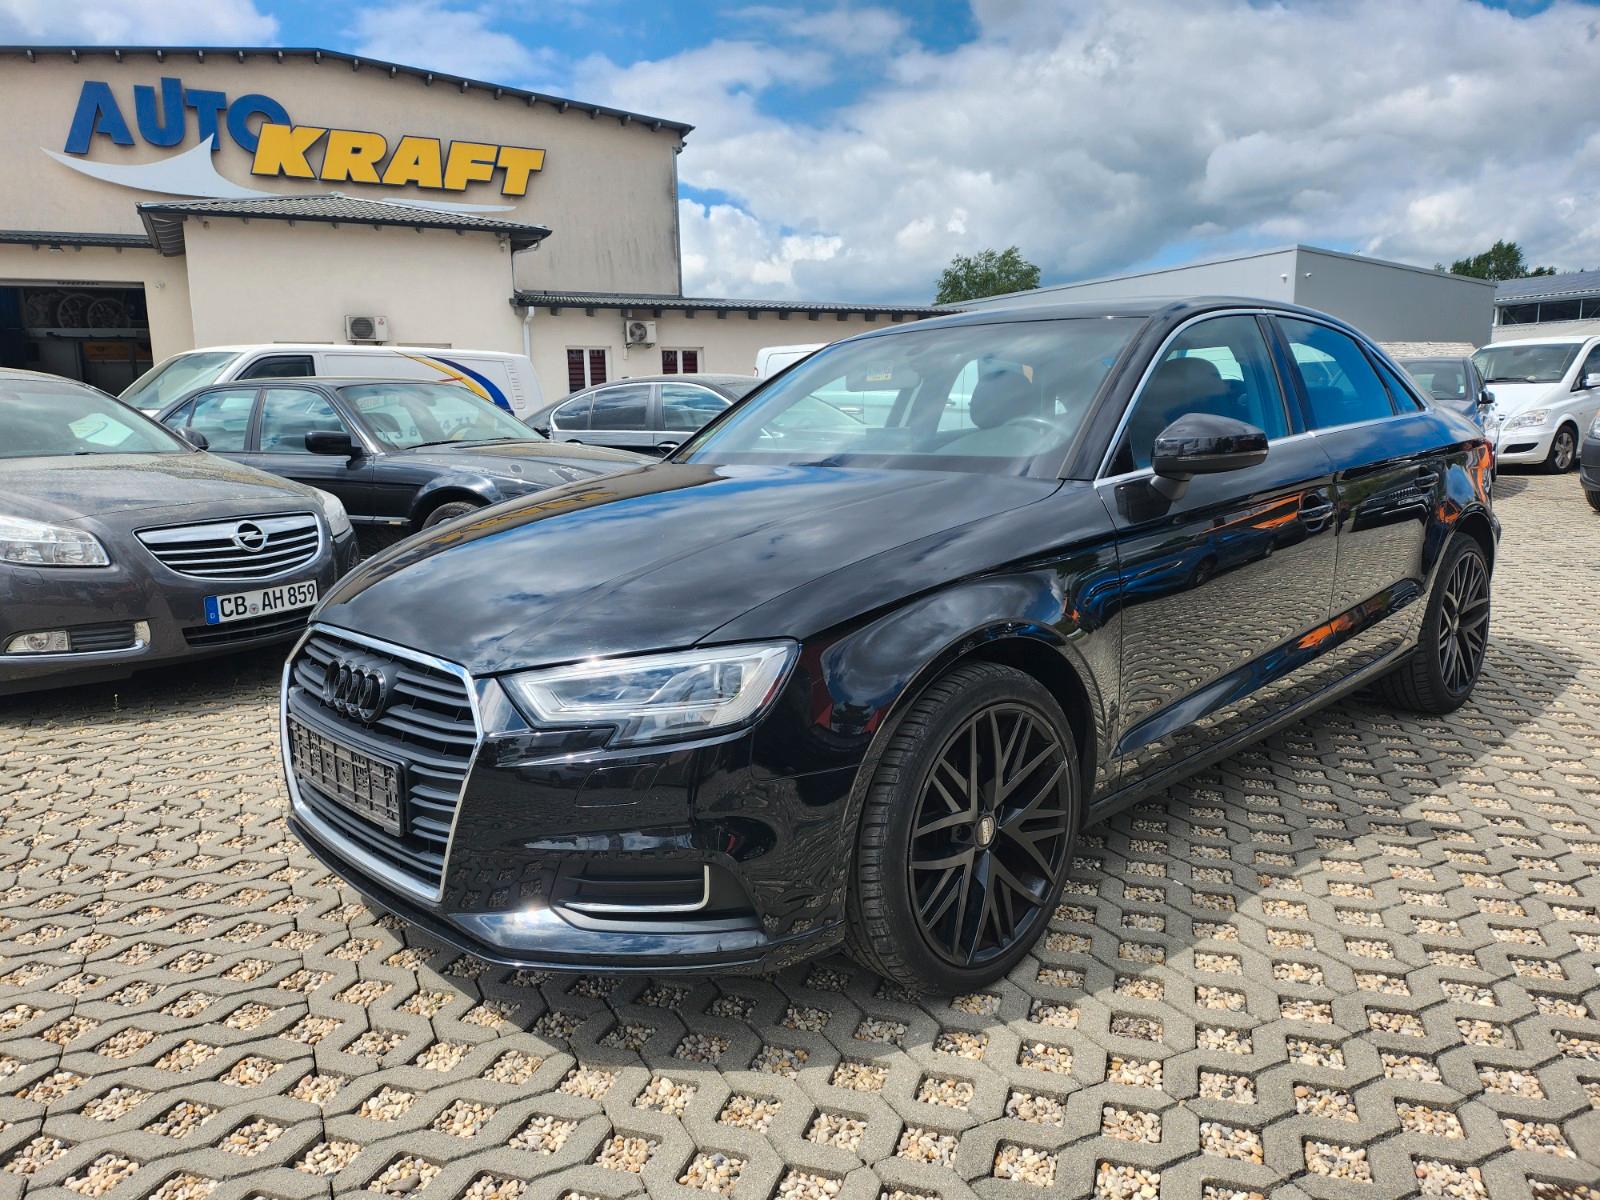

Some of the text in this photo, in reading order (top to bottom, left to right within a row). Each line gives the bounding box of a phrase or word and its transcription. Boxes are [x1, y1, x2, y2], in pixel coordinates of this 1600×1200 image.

[64, 77, 291, 154] AUTO
[250, 121, 546, 196] KRAFT
[220, 595, 247, 617] CB
[262, 588, 285, 611] AH
[287, 583, 315, 606] 859
